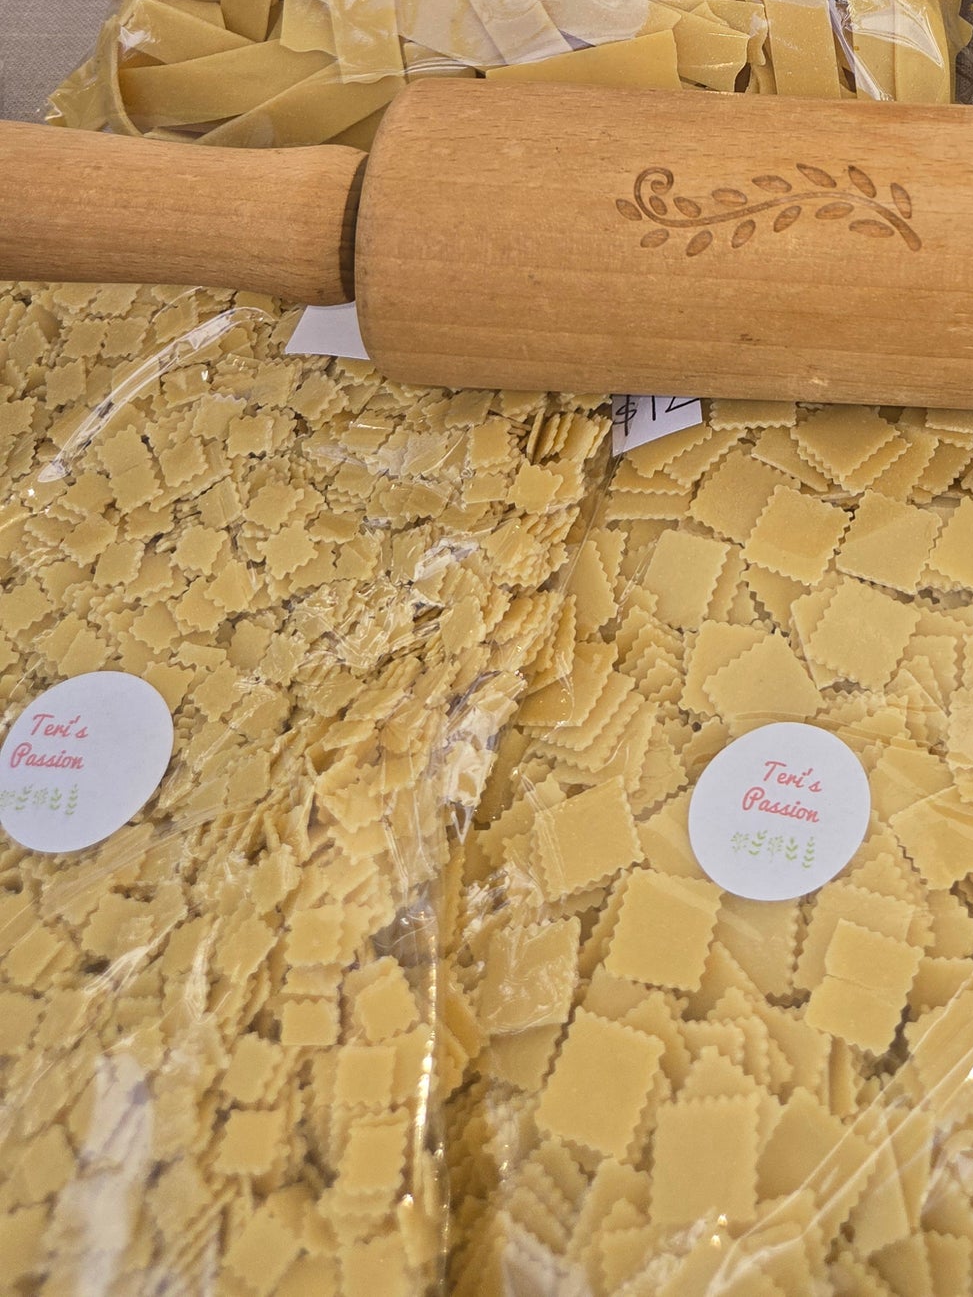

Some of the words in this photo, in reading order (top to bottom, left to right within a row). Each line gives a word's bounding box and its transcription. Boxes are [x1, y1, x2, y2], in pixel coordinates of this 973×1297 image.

[30, 712, 89, 739] Teri's
[9, 741, 85, 770] Passion
[763, 760, 822, 793] Teri's
[742, 786, 820, 823] Passion
